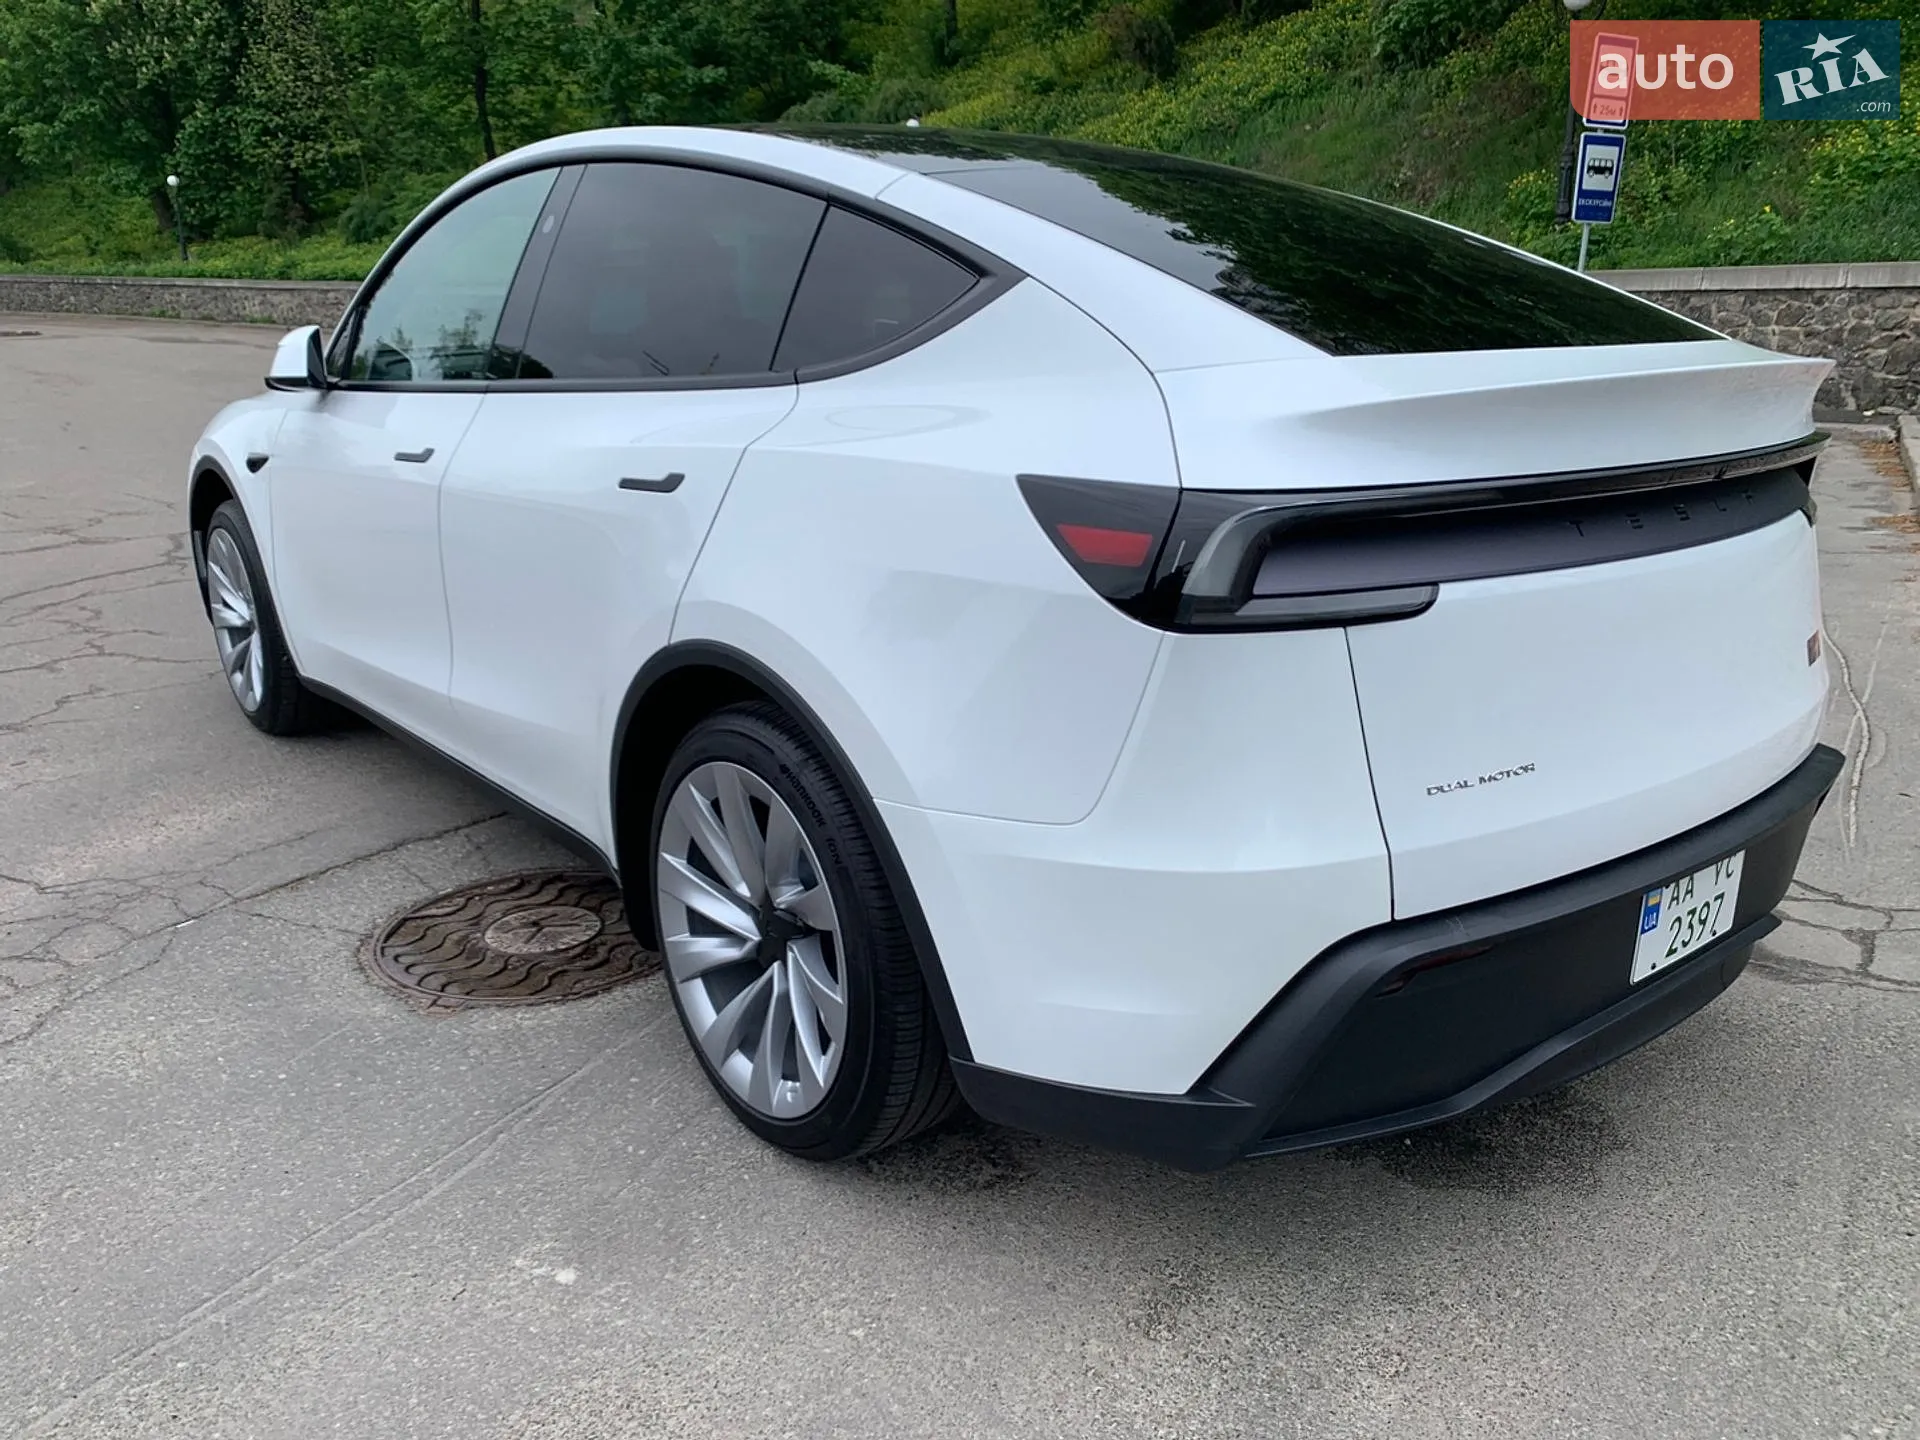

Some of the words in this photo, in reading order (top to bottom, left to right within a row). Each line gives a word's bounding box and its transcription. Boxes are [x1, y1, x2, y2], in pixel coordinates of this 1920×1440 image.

[1568, 489, 1755, 537] TESLA
[1426, 779, 1475, 797] DUAL
[1478, 762, 1536, 785] MOTOR
[1667, 873, 1695, 910] AA
[1643, 911, 1658, 930] UA
[1665, 891, 1726, 958] 2397
